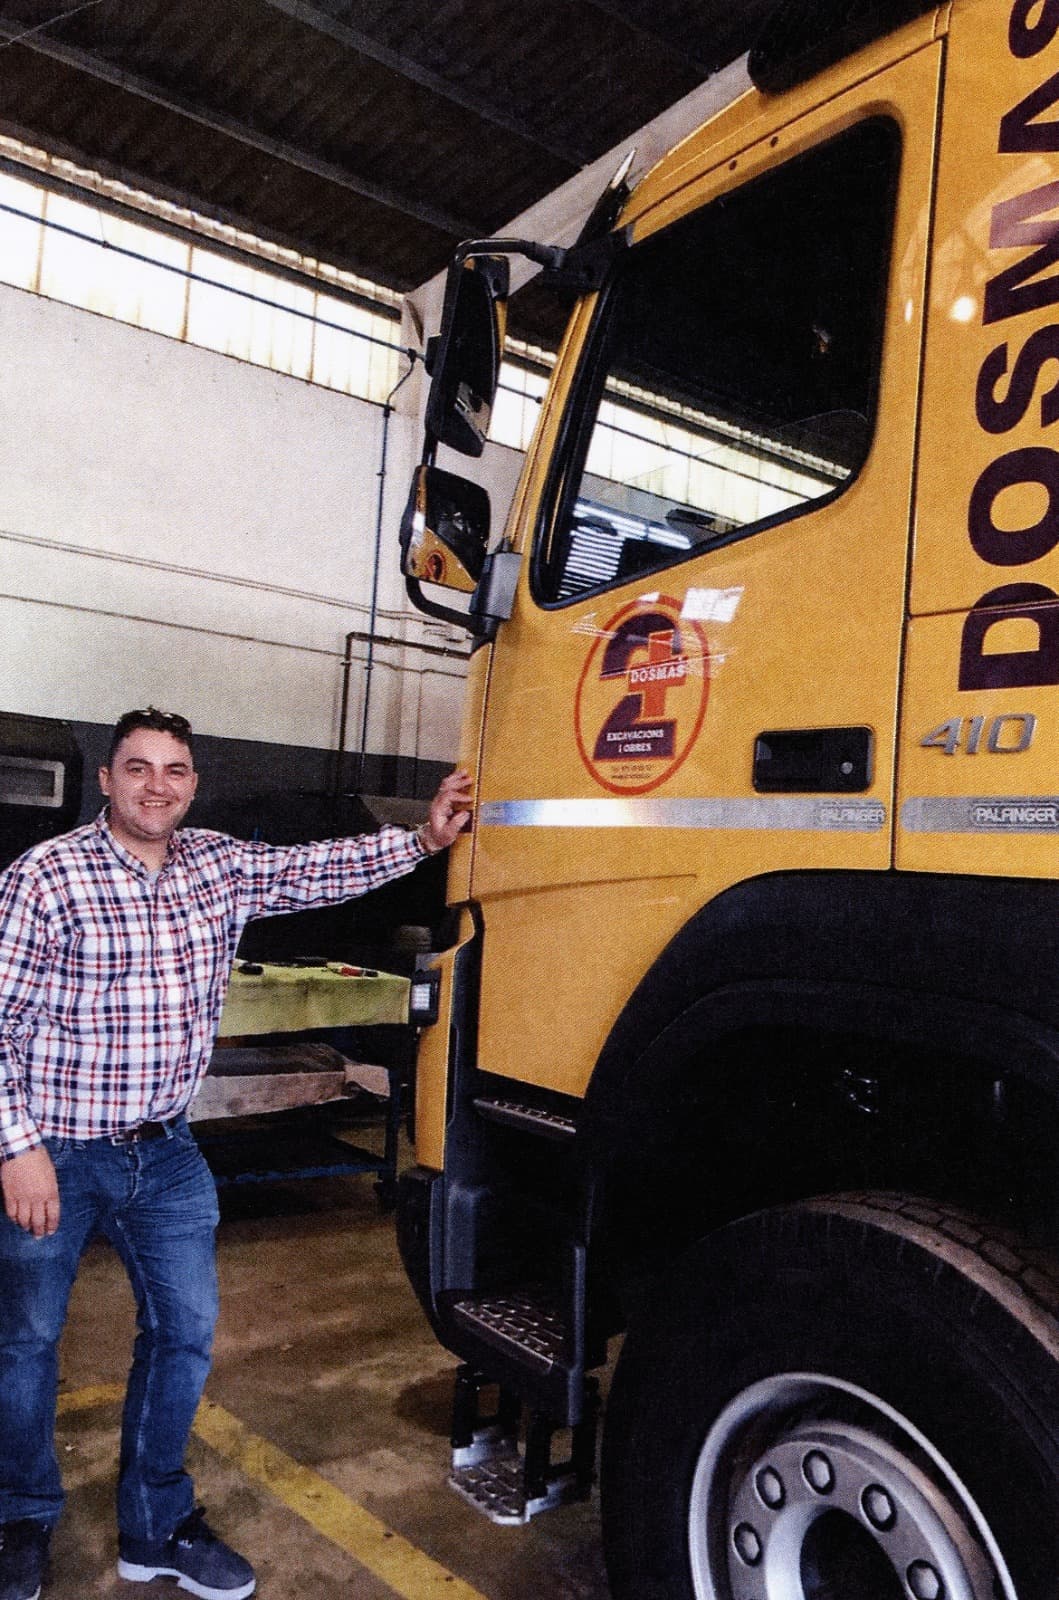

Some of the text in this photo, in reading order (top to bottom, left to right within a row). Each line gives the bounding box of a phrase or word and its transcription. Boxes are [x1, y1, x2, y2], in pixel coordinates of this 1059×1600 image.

[630, 664, 686, 684] DOSMAS
[606, 729, 664, 742] EXCAVACIONS
[919, 712, 1037, 755] 410
[976, 807, 1057, 822] PALFINGER
